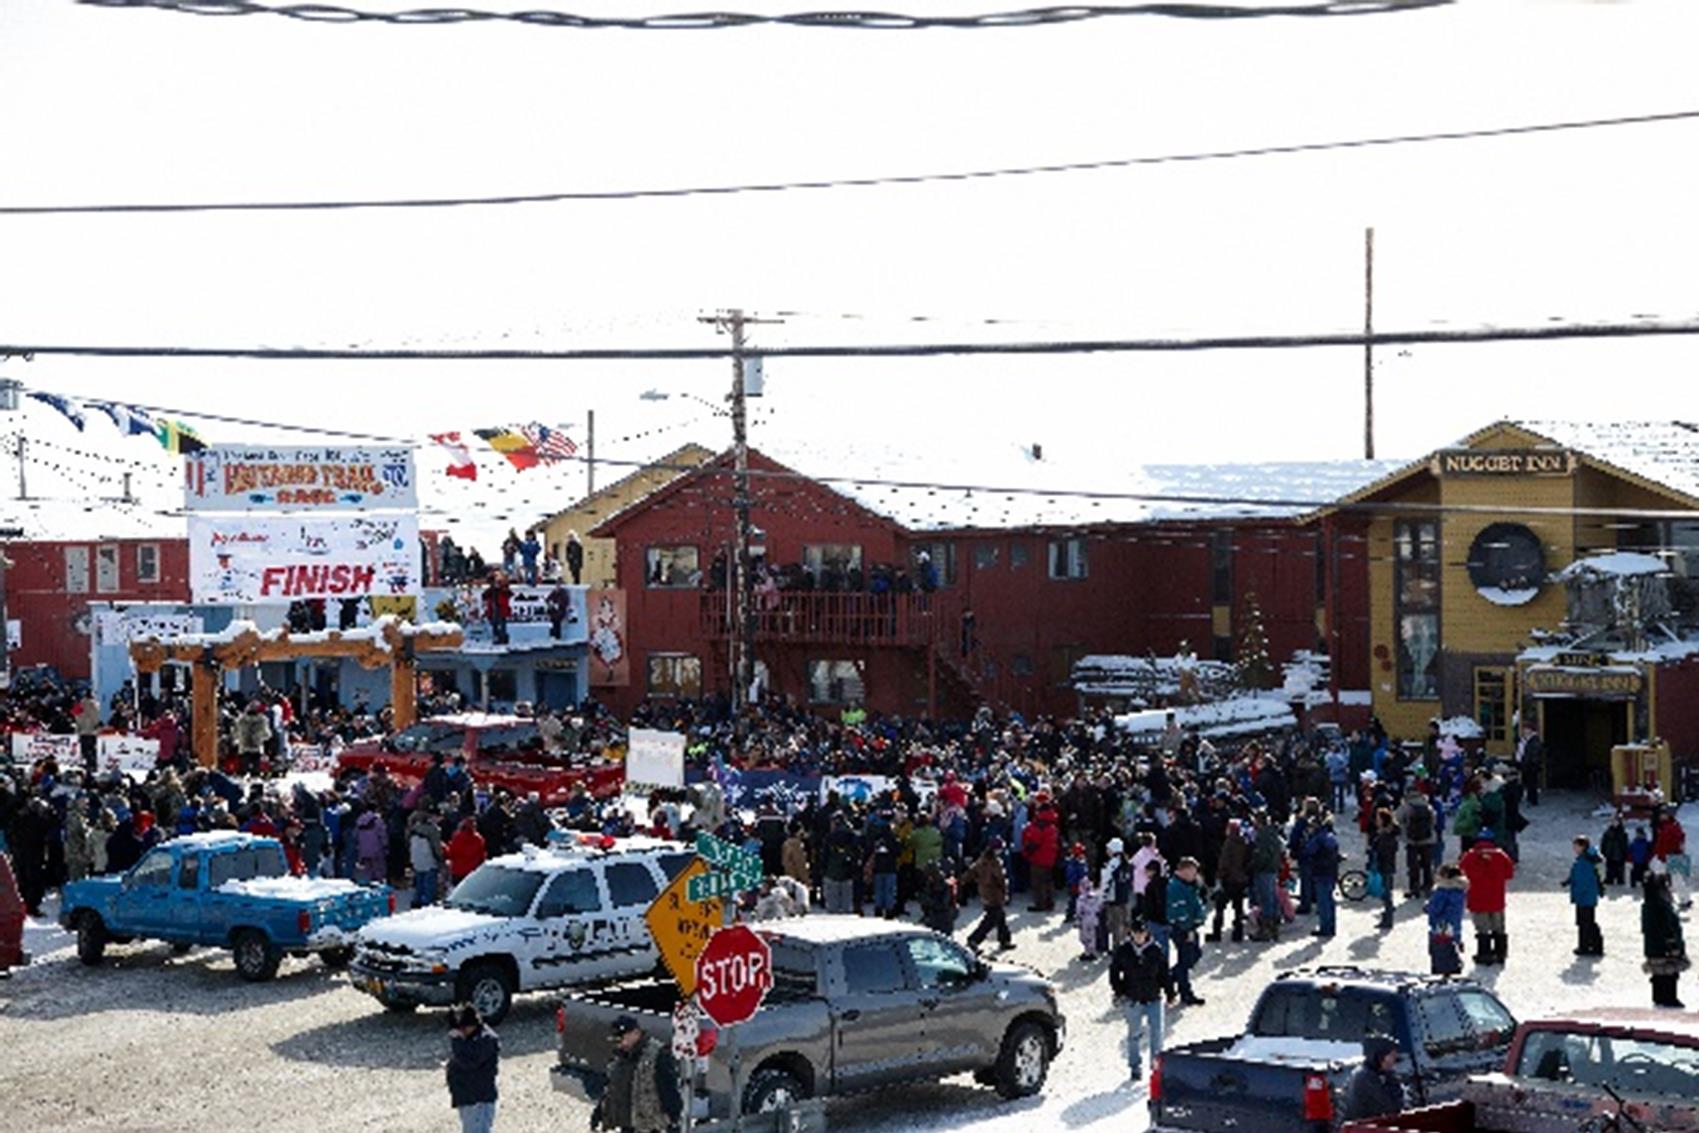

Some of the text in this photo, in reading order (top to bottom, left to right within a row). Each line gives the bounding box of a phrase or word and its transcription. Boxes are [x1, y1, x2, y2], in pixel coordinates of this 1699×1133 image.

[1446, 455, 1561, 472] NUGGET INN
[260, 564, 375, 596] FINISH
[701, 952, 764, 1000] STOP
